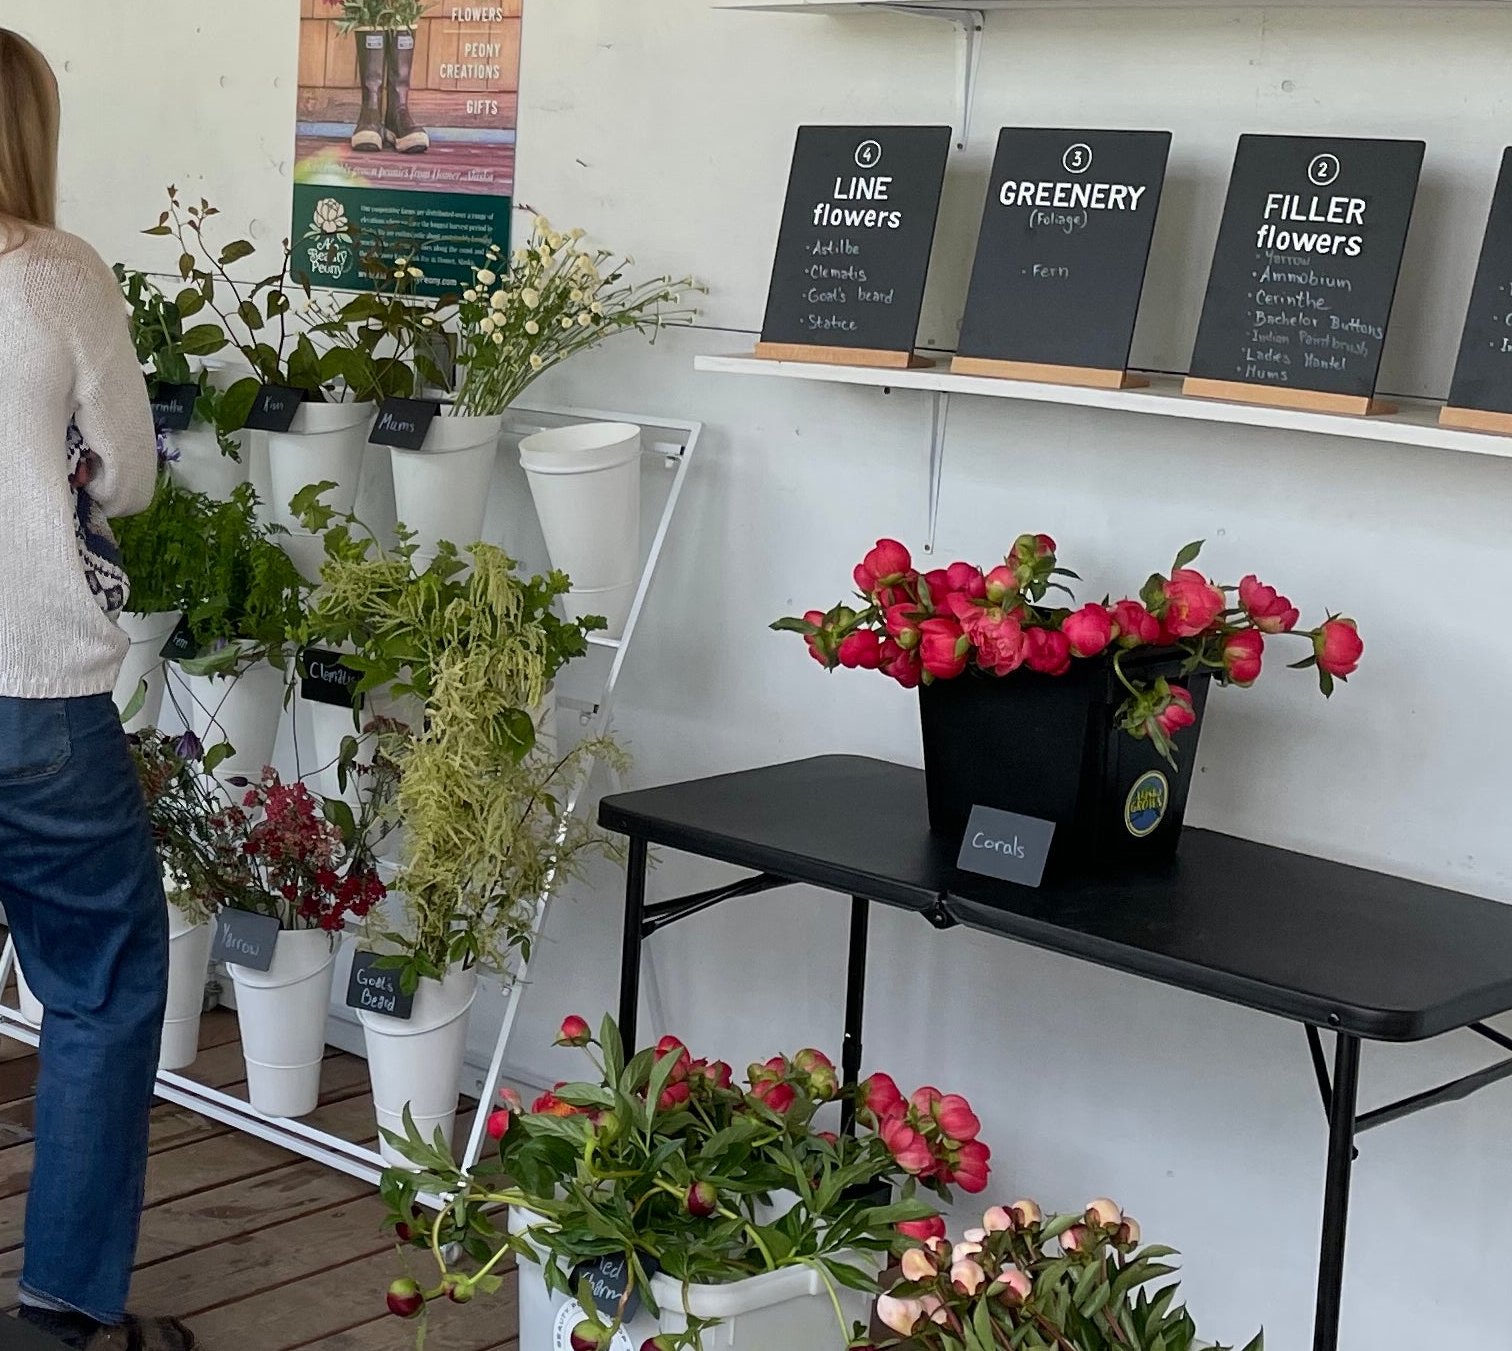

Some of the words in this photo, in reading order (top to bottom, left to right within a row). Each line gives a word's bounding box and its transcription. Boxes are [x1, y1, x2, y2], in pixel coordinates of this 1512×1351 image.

[451, 7, 503, 23] FLOWERS
[464, 43, 501, 58] PEONY
[439, 63, 500, 80] CREATIONS
[466, 99, 498, 115] GIFTS
[862, 147, 872, 162] 4
[1072, 151, 1082, 166] 3
[1317, 162, 1328, 177] 2
[834, 176, 893, 200] LINE
[999, 180, 1146, 211] GREENERY
[813, 203, 902, 229] flowers
[1263, 193, 1366, 225] FILLER
[1029, 209, 1088, 234] (Foliage)
[1256, 224, 1363, 256] flowers
[312, 260, 341, 279] Peony
[810, 264, 867, 282] Clematis
[1033, 264, 1069, 278] Fern
[1259, 265, 1352, 292] Ammobium
[858, 286, 894, 304] beard
[1255, 289, 1332, 310] Cerinthe
[1254, 310, 1318, 327] Bachelor
[1329, 315, 1383, 340] Buttons
[379, 409, 416, 433] Mums
[972, 831, 1025, 859] Corals
[222, 922, 261, 956] Yarrow
[360, 988, 396, 1013] Beard
